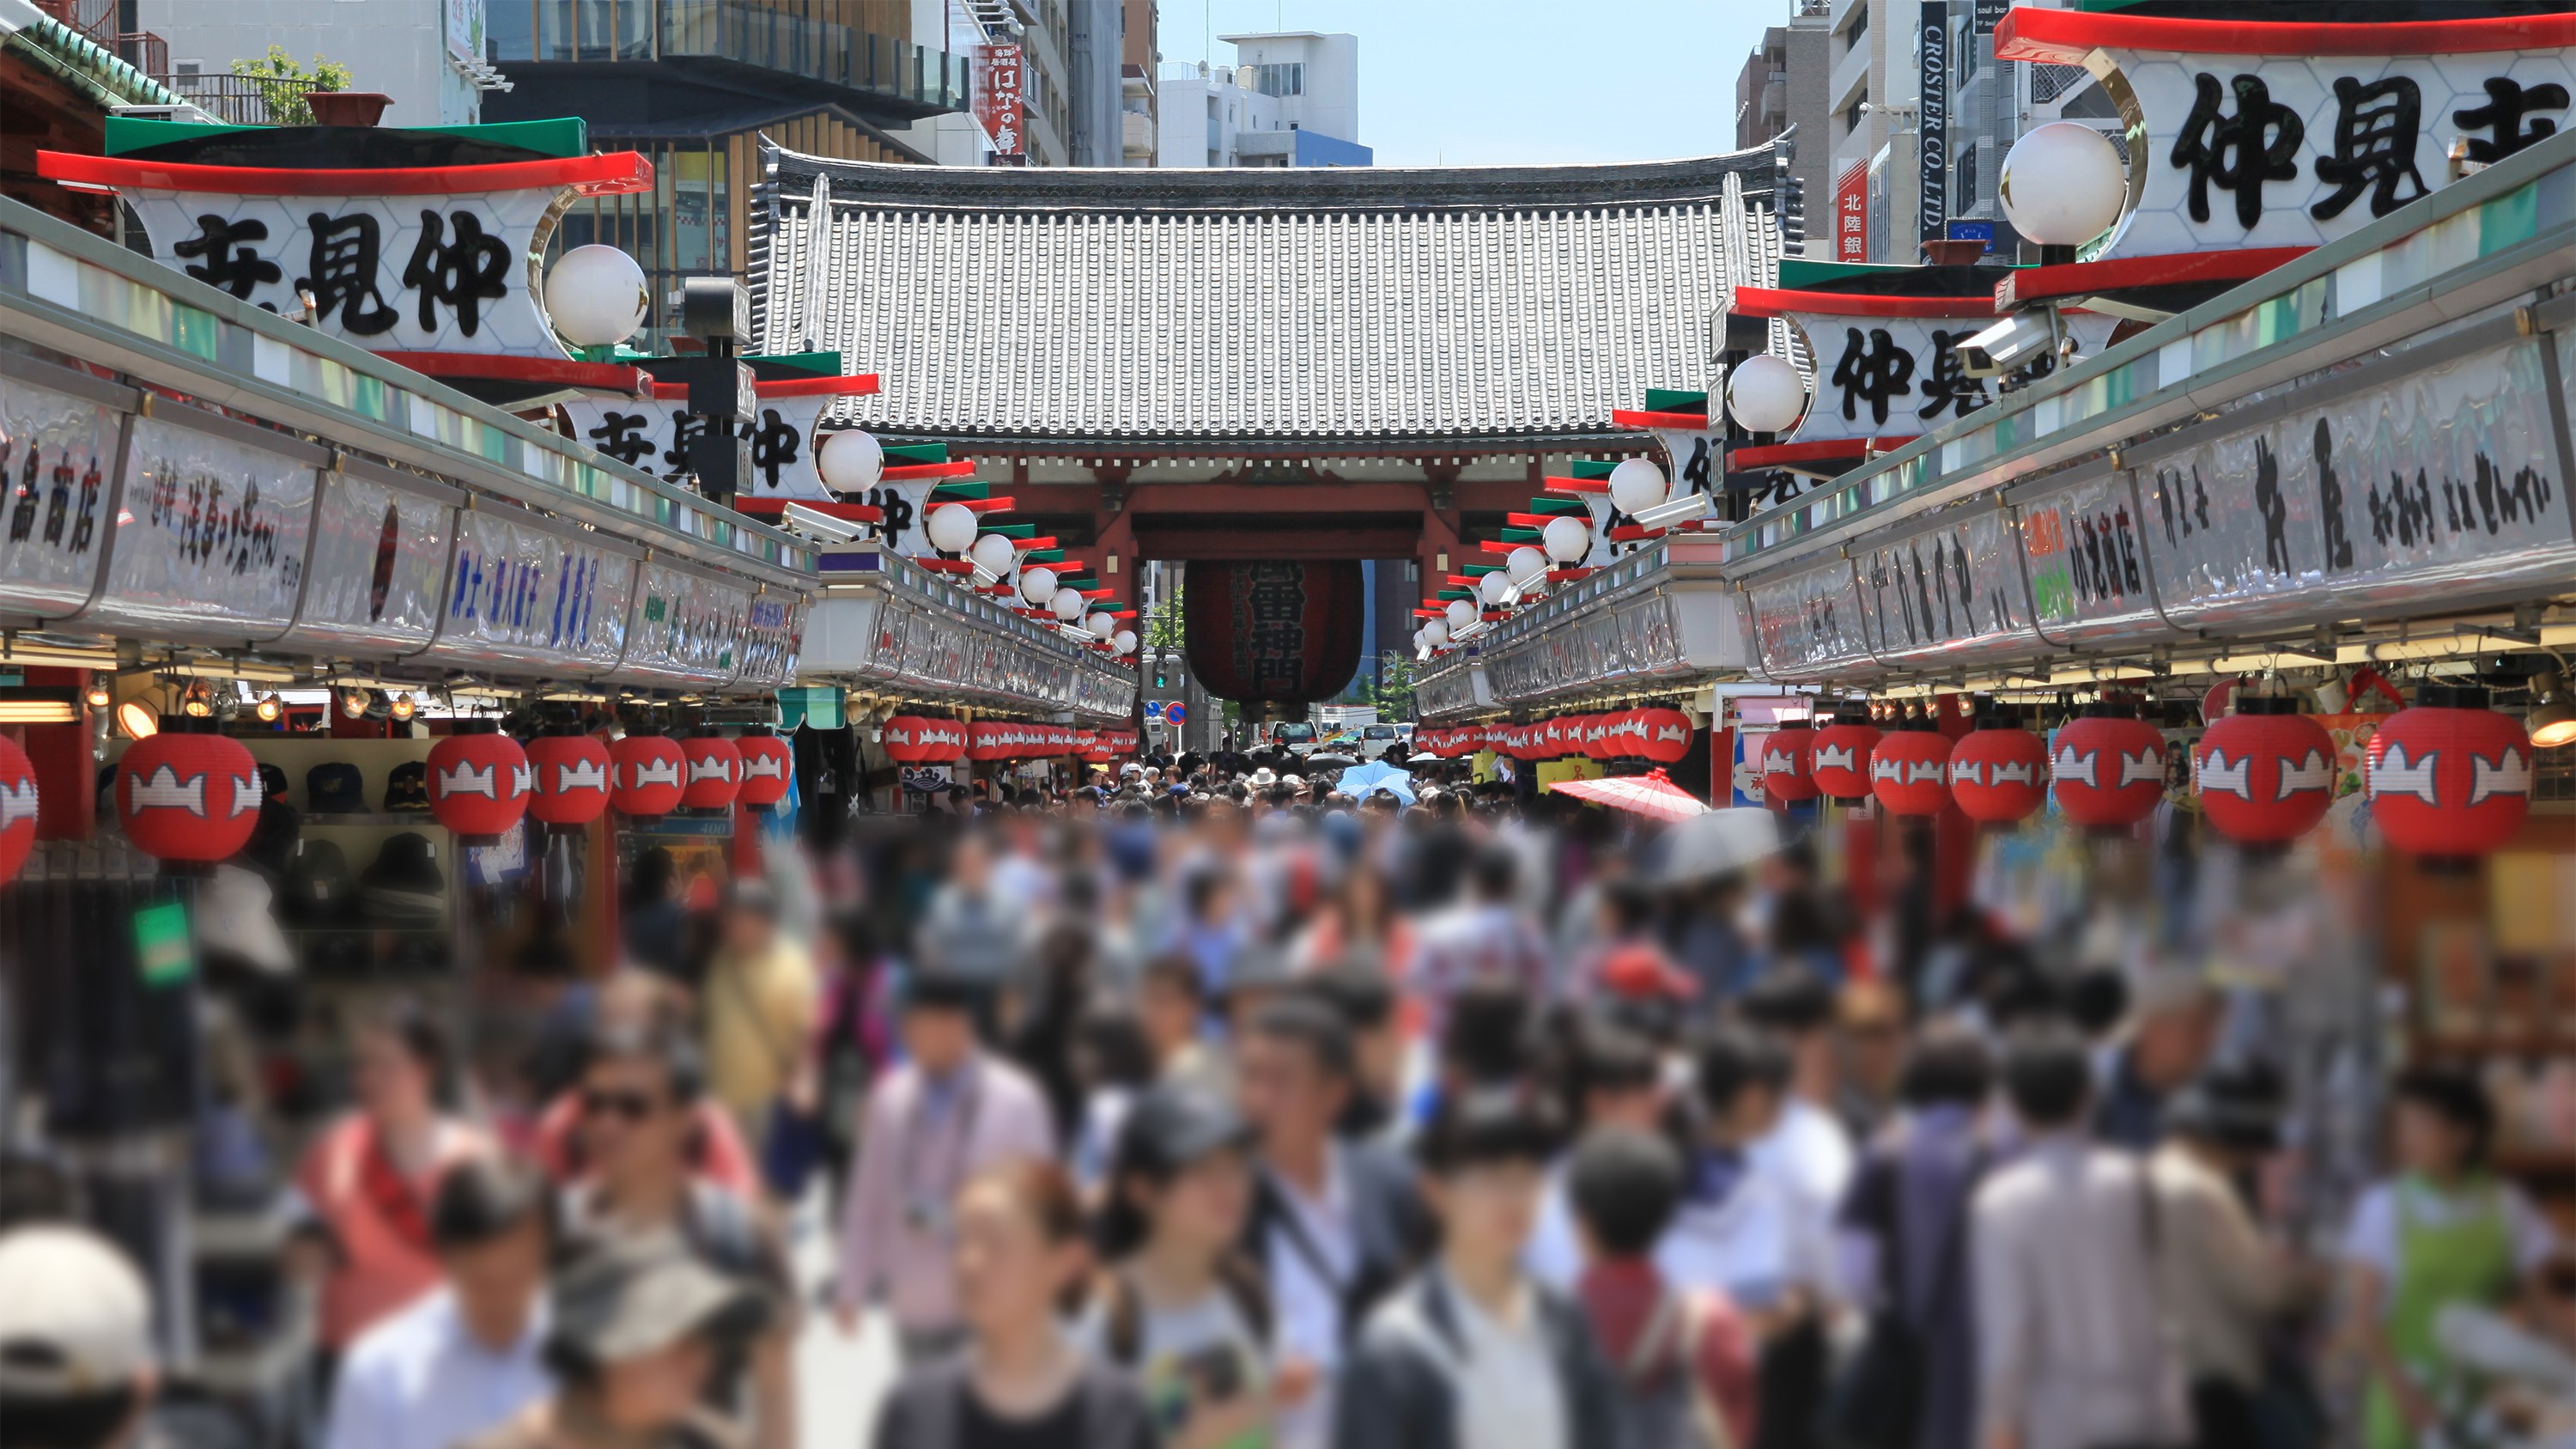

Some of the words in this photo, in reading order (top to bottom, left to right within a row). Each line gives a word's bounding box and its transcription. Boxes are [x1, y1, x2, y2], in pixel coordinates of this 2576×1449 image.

[1995, 5, 2008, 14] bar
[994, 70, 1018, 155] はなの舞
[1924, 25, 1943, 130] CROSTER
[1923, 137, 1942, 231] CO.,LTD.
